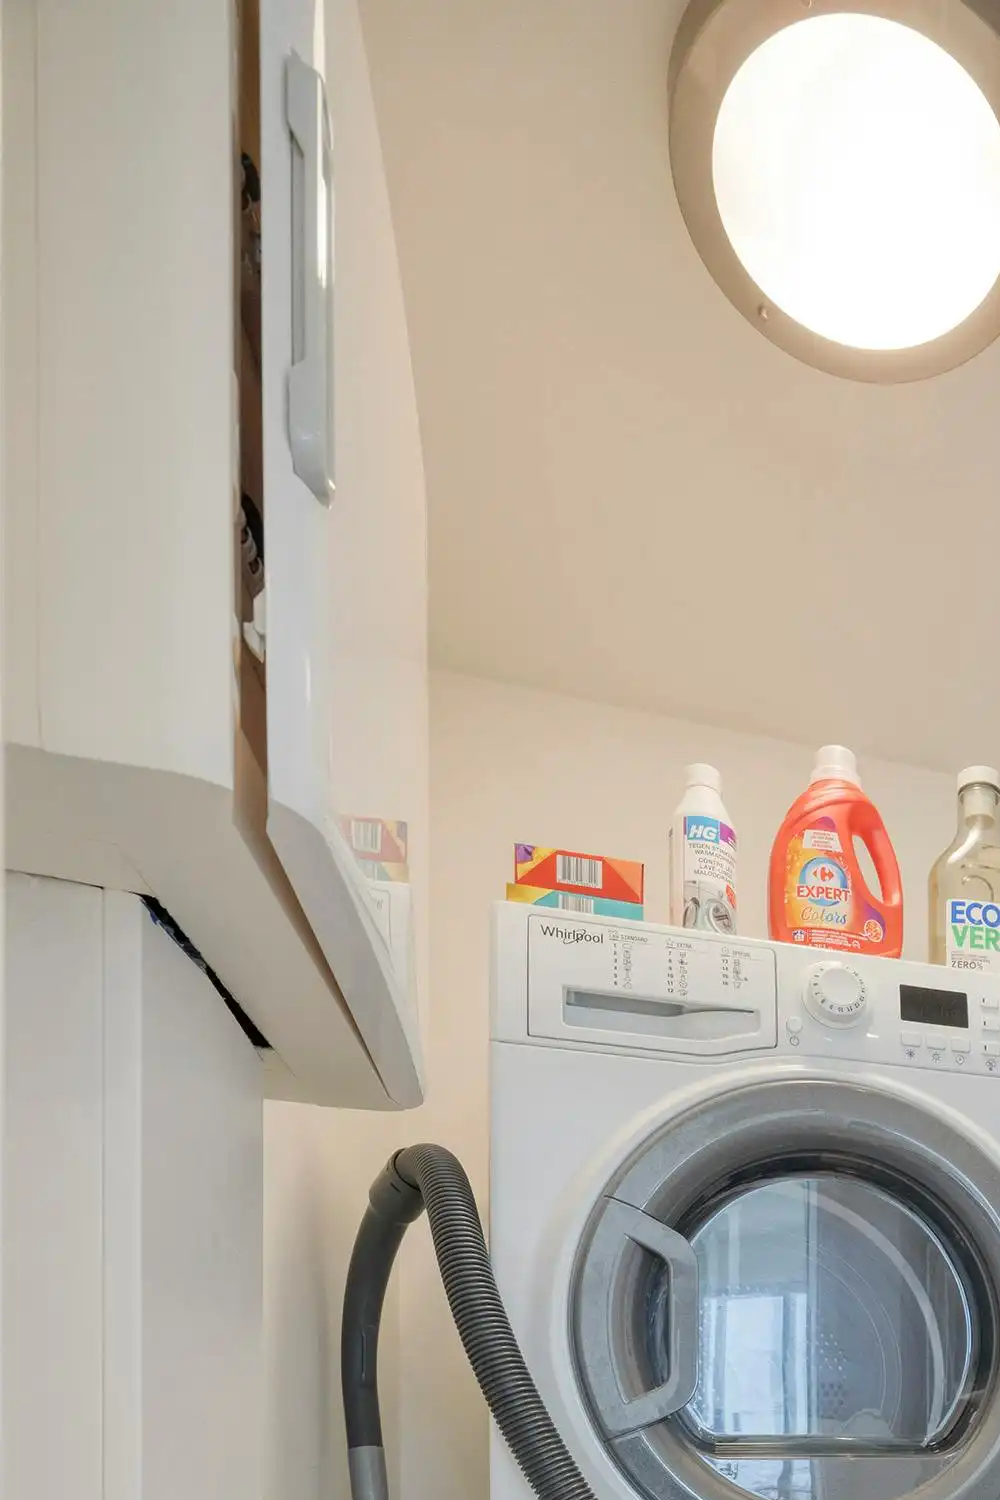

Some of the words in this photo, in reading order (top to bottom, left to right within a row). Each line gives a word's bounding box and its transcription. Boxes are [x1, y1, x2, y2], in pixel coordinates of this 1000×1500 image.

[689, 824, 718, 840] HG
[796, 885, 851, 902] EXPERT
[800, 906, 847, 925] Colors
[540, 924, 604, 945] Whirlpool
